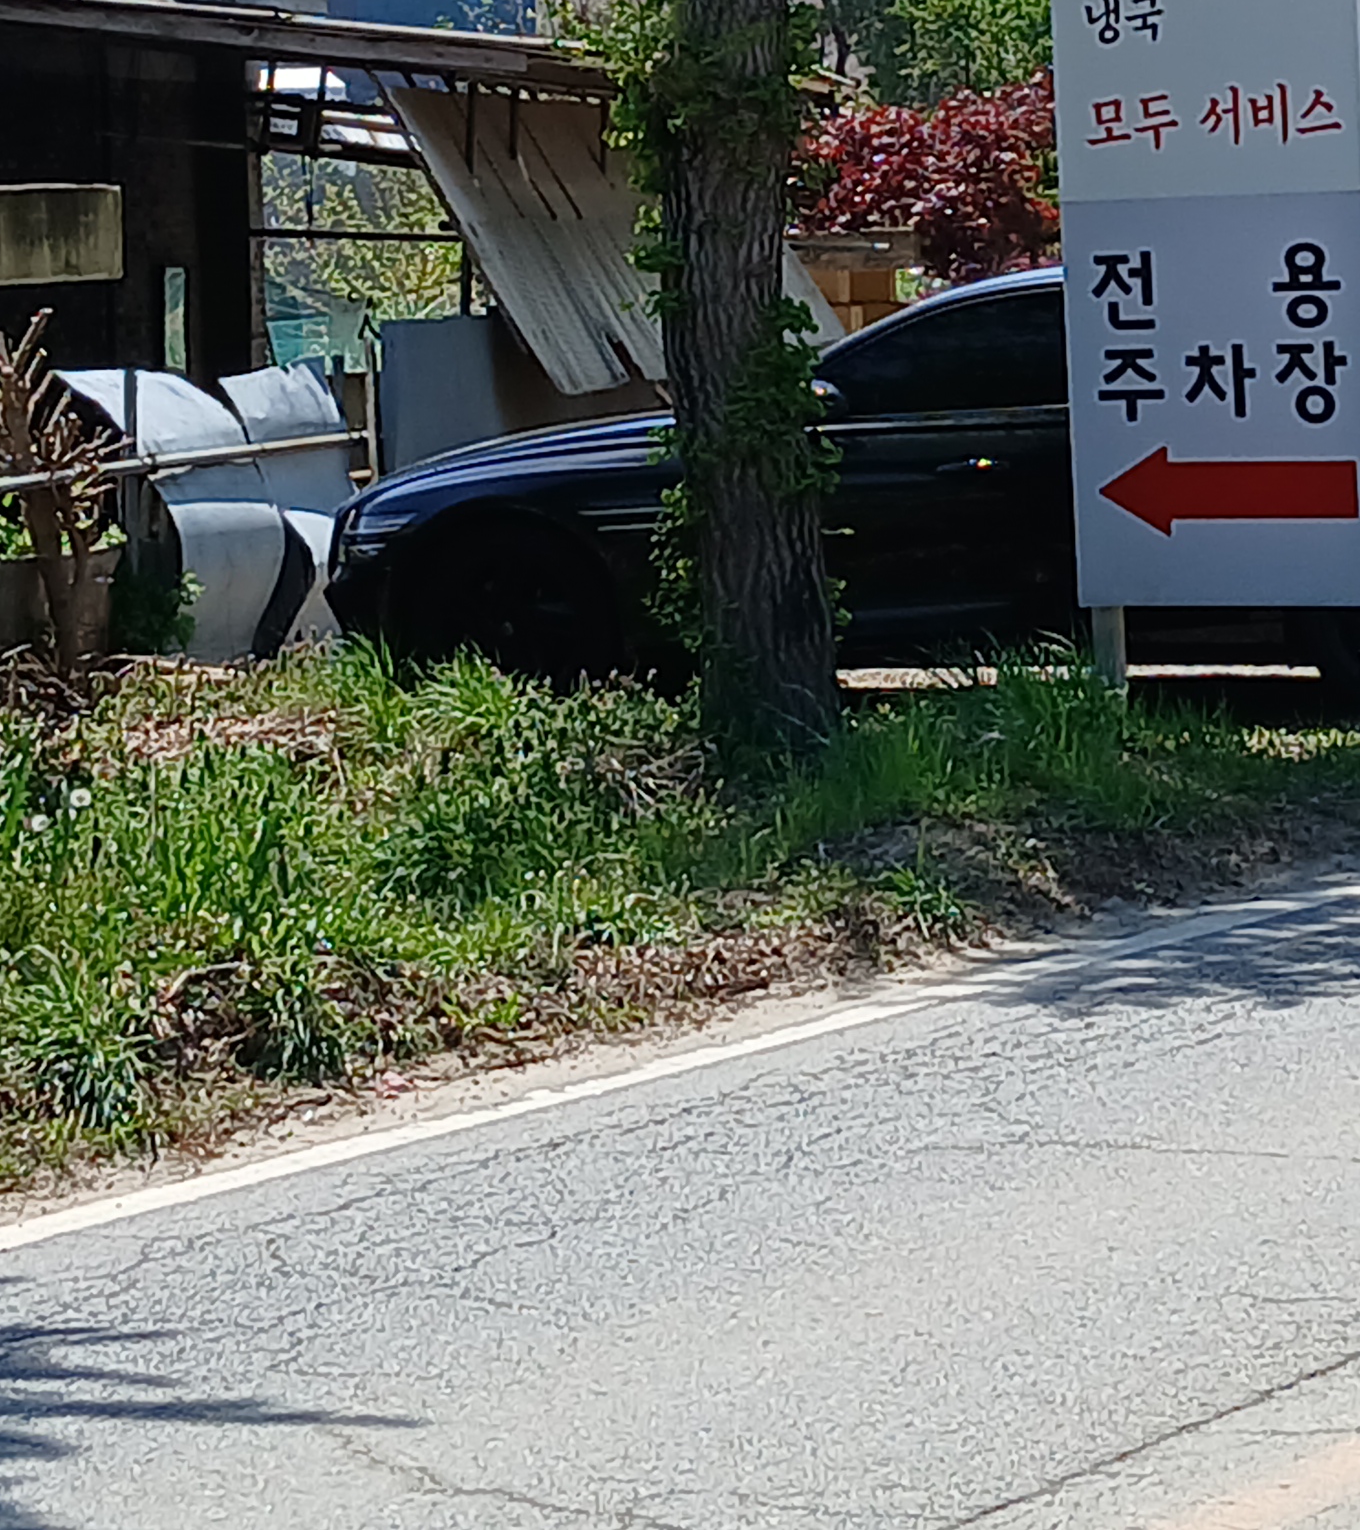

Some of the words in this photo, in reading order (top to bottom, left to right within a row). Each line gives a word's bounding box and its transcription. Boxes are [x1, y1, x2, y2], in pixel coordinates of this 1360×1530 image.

[1085, 93, 1180, 152] 모두
[1198, 81, 1343, 147] 서비스
[1096, 339, 1349, 425] 주차장
